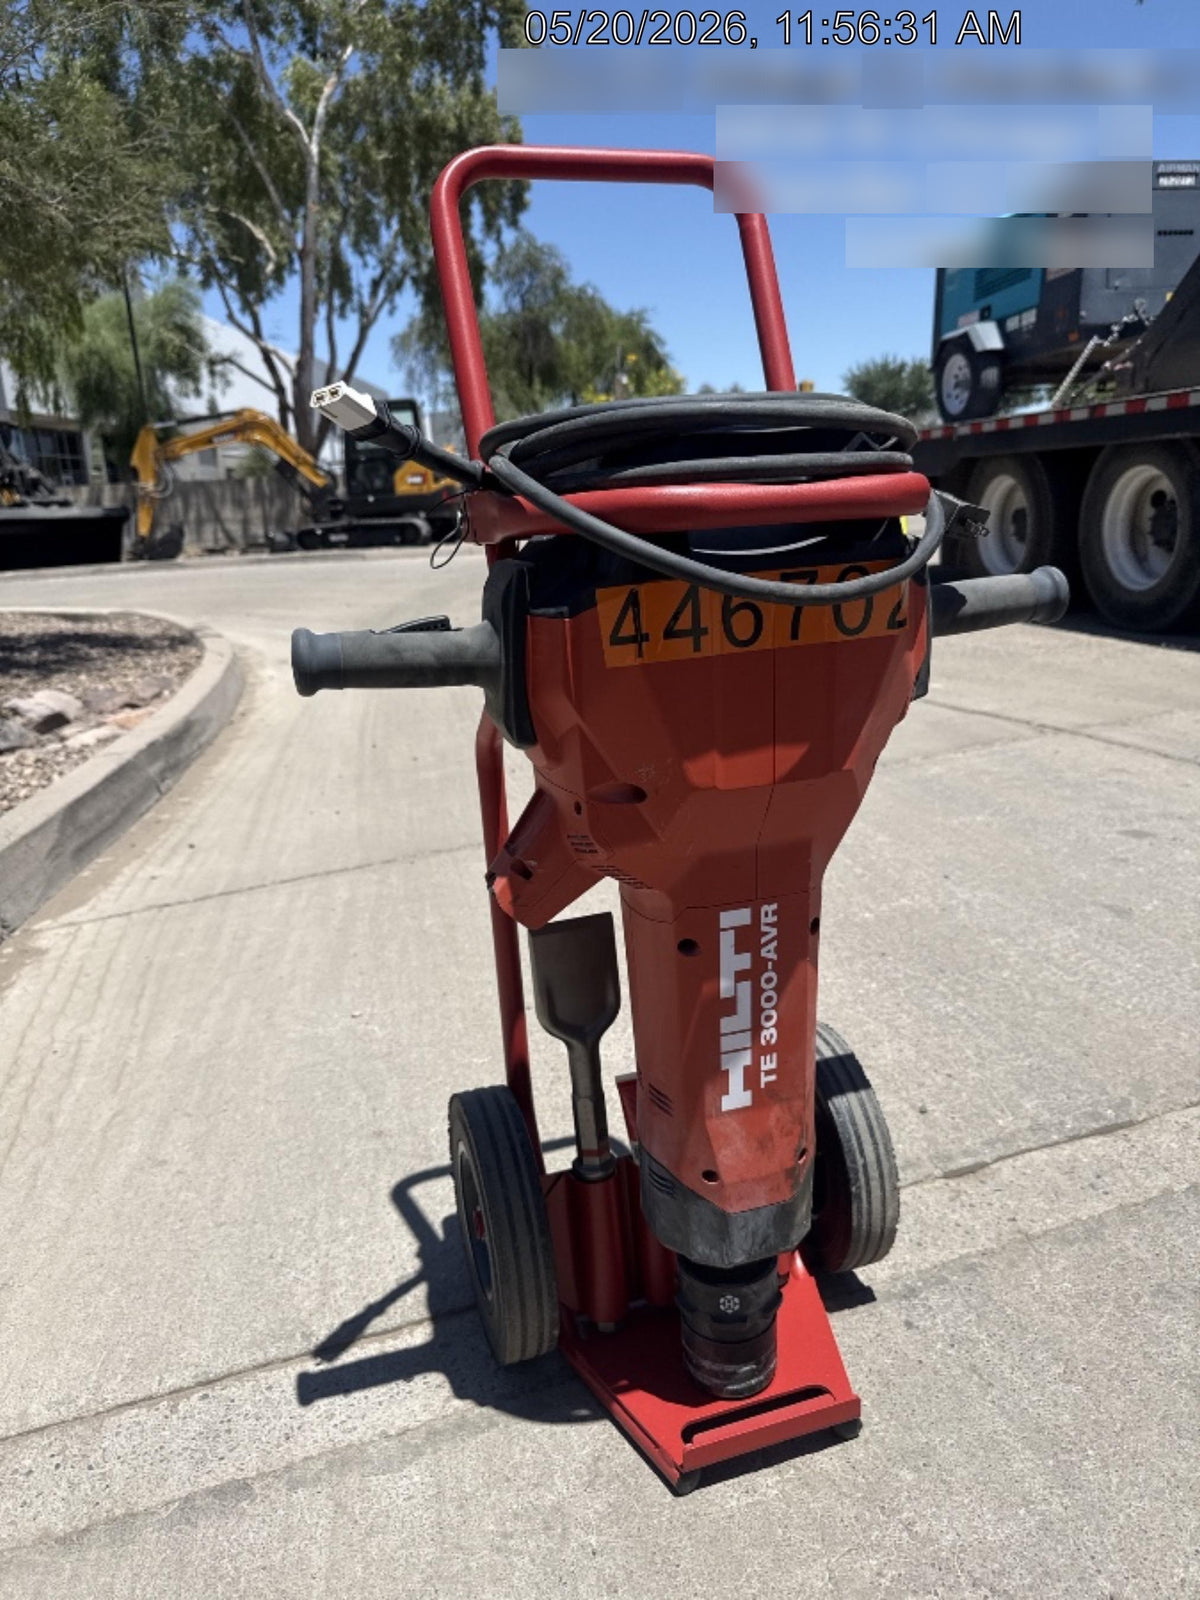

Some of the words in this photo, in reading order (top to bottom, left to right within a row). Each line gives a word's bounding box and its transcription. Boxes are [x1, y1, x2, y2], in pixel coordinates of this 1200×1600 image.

[720, 907, 752, 1112] HILTI
[760, 902, 778, 1047] 3000-AVR
[760, 1052, 777, 1088] TE
